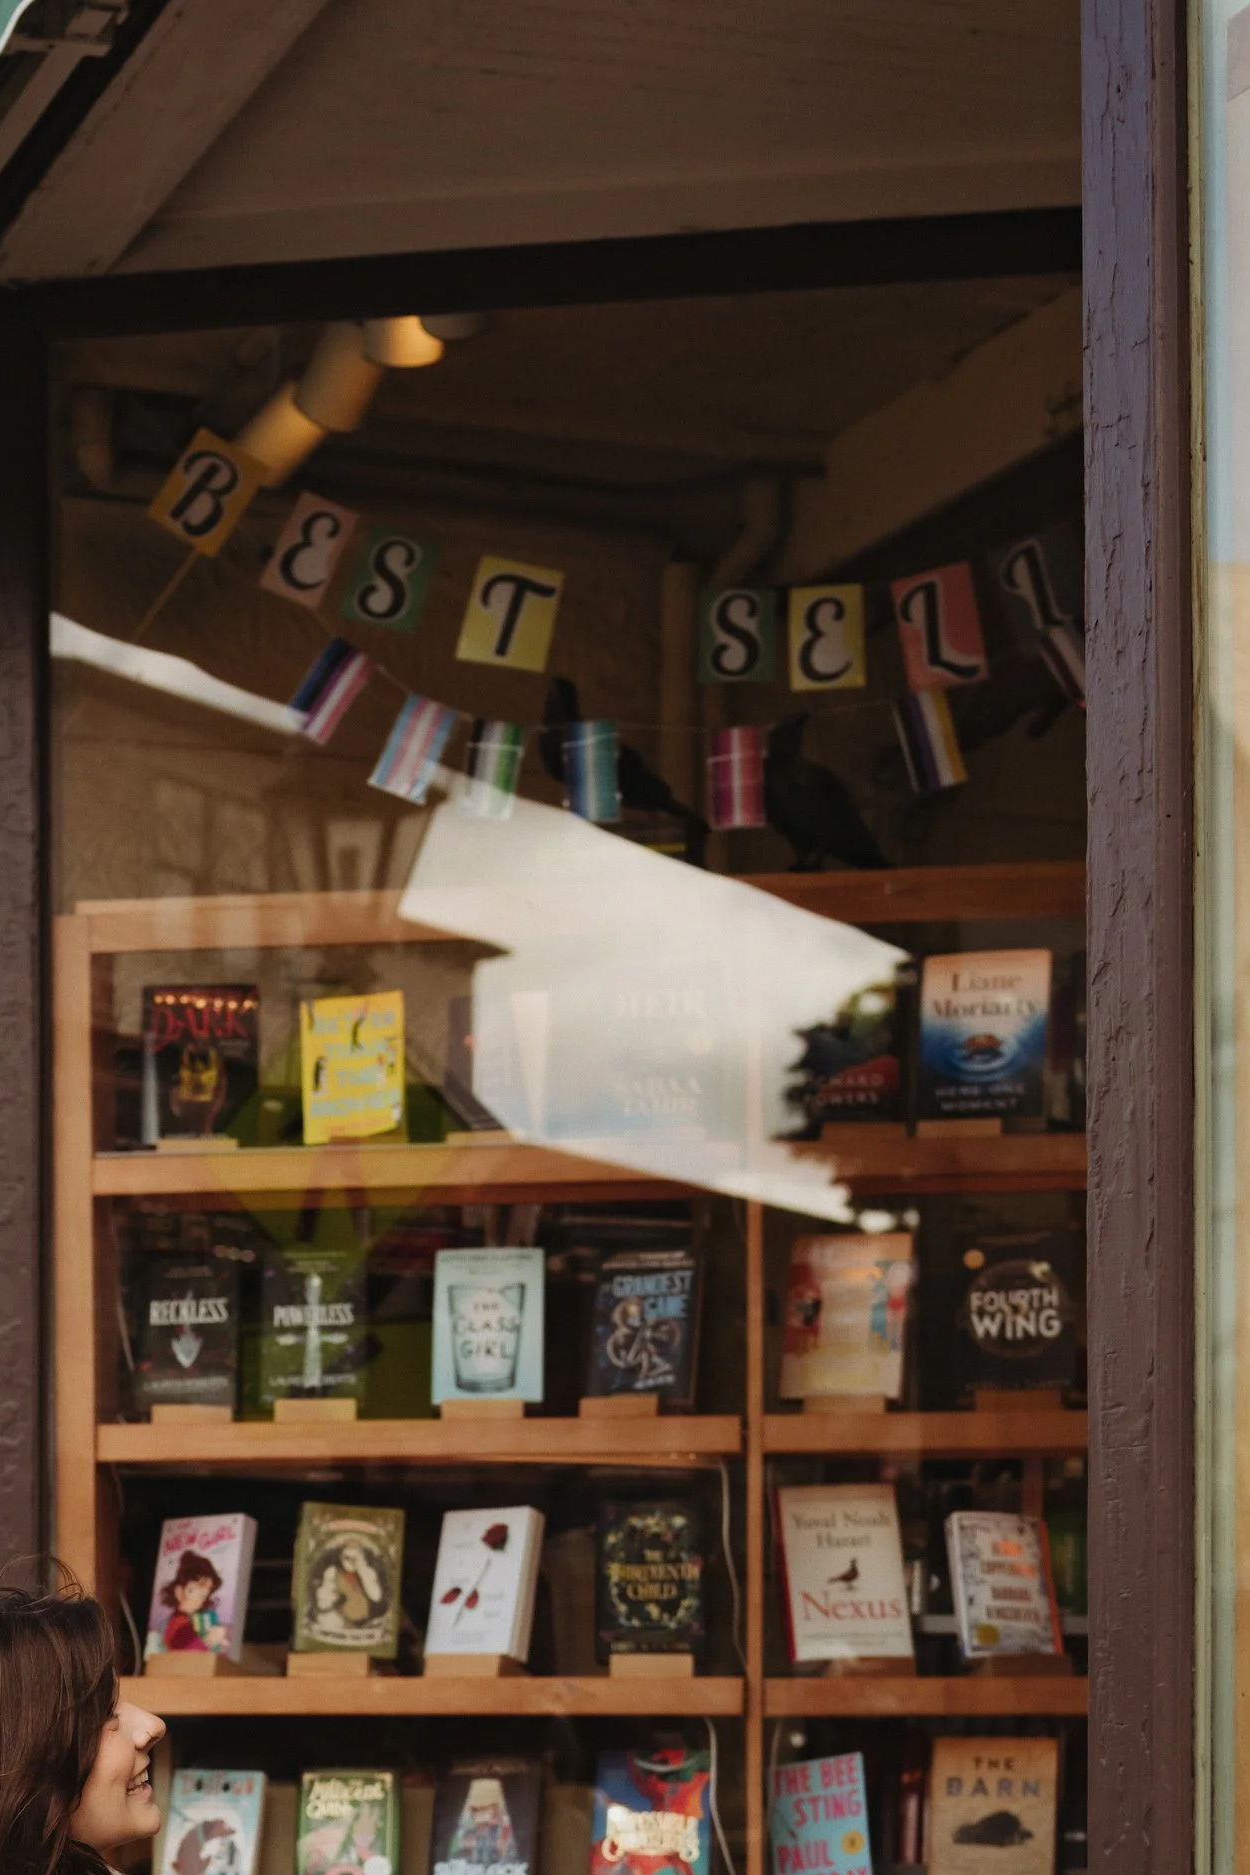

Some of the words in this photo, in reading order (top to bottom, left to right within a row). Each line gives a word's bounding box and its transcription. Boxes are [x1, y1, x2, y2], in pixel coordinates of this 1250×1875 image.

[168, 450, 557, 657] BEST
[708, 540, 1080, 682] SELL
[149, 1298, 229, 1326] RECKLESS
[970, 1286, 1060, 1312] FOURTH
[970, 1307, 1062, 1340] WING
[800, 1590, 902, 1622] Nexus
[774, 1765, 810, 1798] THE
[819, 1755, 859, 1787] BEE
[946, 1777, 1040, 1798] BARN
[793, 1789, 862, 1827] STING
[777, 1840, 834, 1874] PAUL
